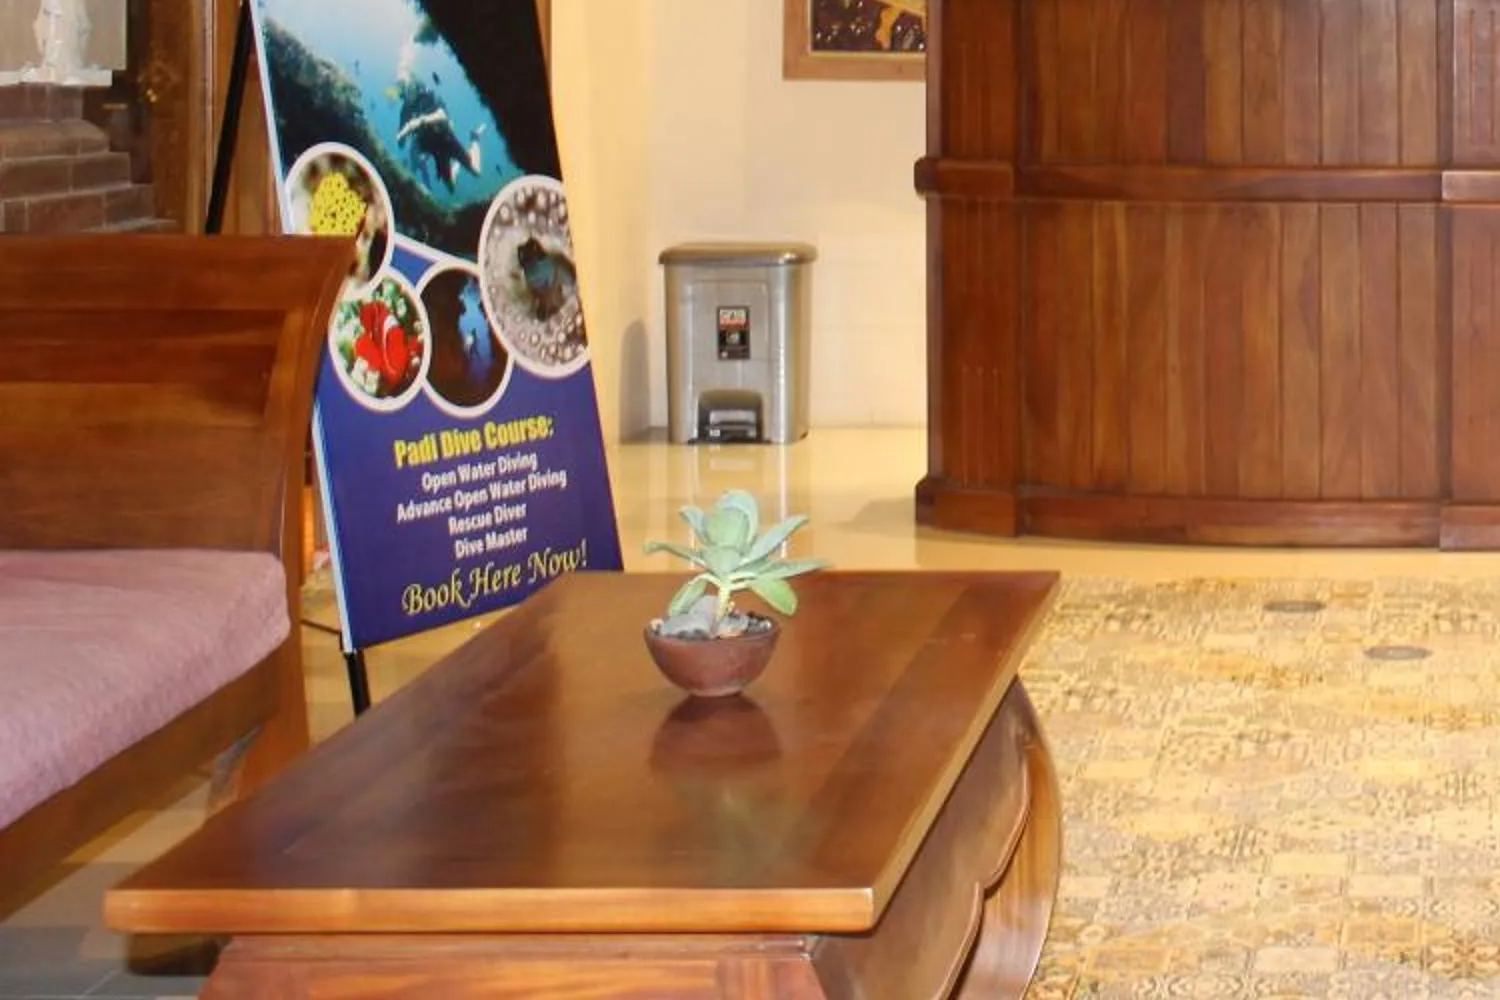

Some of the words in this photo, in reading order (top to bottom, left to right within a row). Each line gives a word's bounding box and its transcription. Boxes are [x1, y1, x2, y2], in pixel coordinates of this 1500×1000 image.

[394, 434, 439, 469] Padi
[440, 428, 482, 459] Dive
[484, 415, 554, 449] Course:
[397, 496, 452, 524] Advance
[453, 488, 489, 512] Open
[489, 479, 527, 501] Water
[528, 468, 567, 492] Diving
[421, 471, 457, 494] Open
[457, 460, 496, 483] Water
[498, 451, 539, 474] Diving
[448, 511, 493, 536] Rescue
[493, 503, 527, 526] Diver
[455, 537, 485, 560] Dive
[485, 526, 529, 551] Master
[401, 567, 472, 617] Book
[469, 561, 522, 597] Here
[527, 538, 588, 585] Now!
